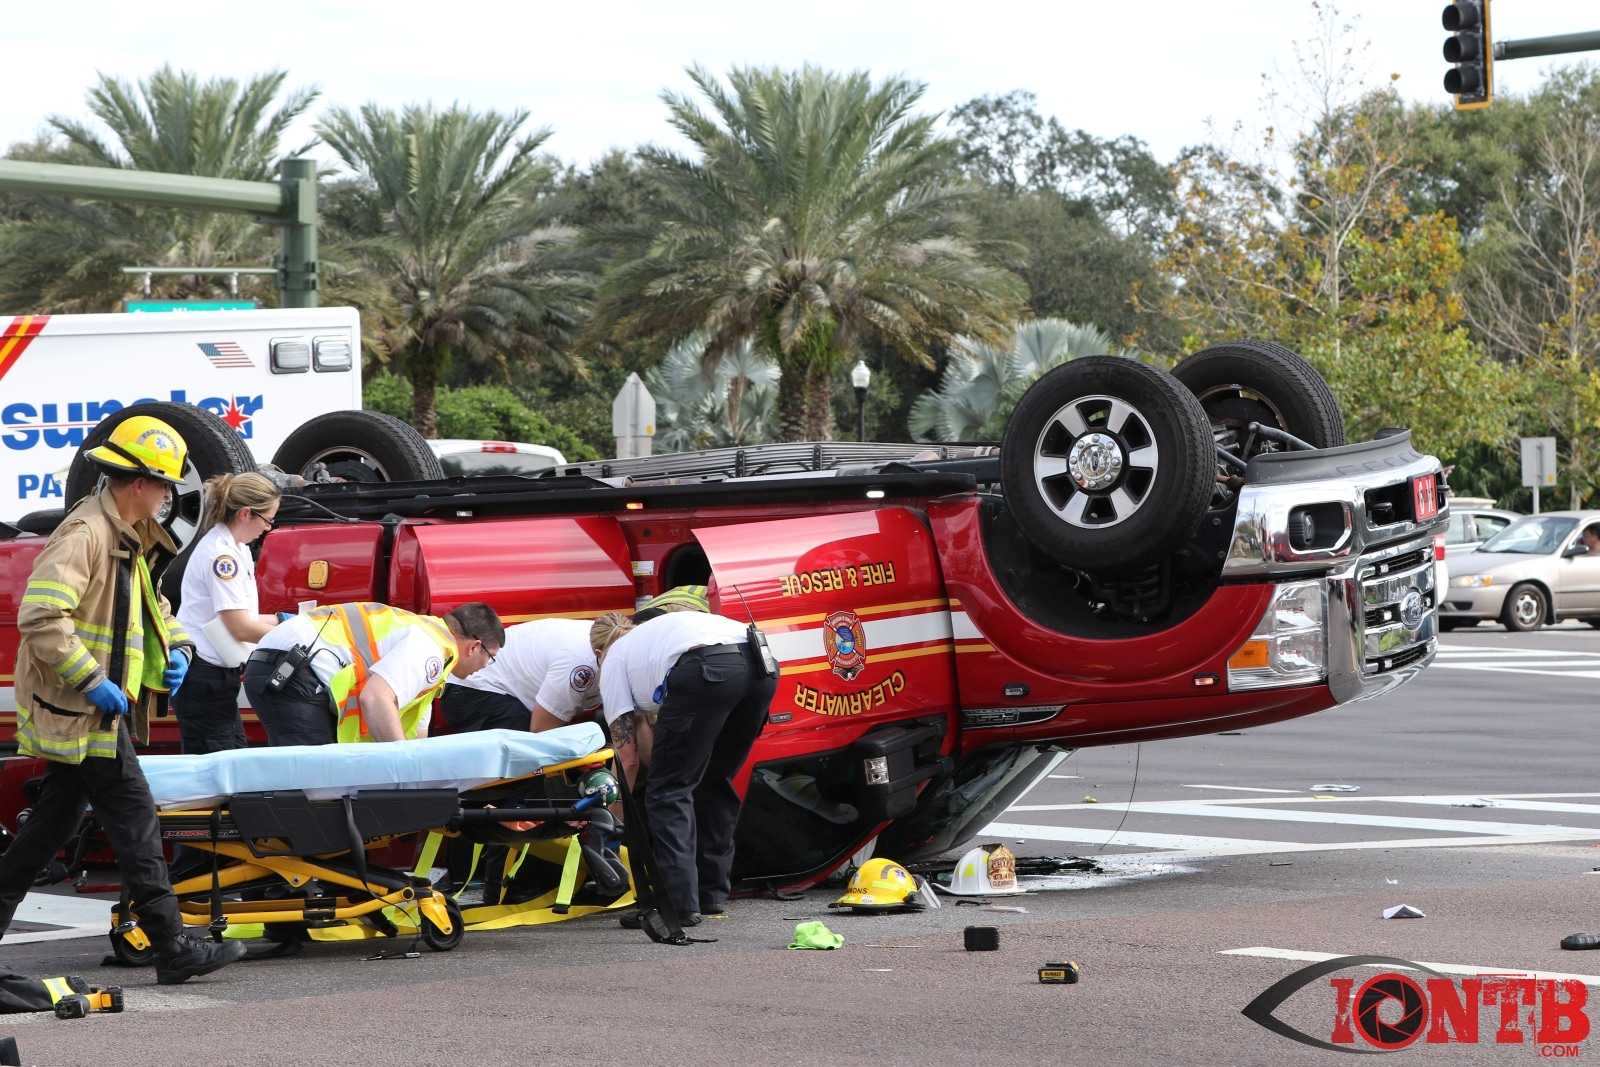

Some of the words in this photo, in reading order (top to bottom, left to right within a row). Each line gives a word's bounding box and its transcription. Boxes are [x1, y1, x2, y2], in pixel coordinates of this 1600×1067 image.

[779, 567, 844, 597] RESCUE
[845, 567, 858, 588] &
[860, 560, 896, 586] FIRE
[794, 669, 906, 716] CLEARWATER
